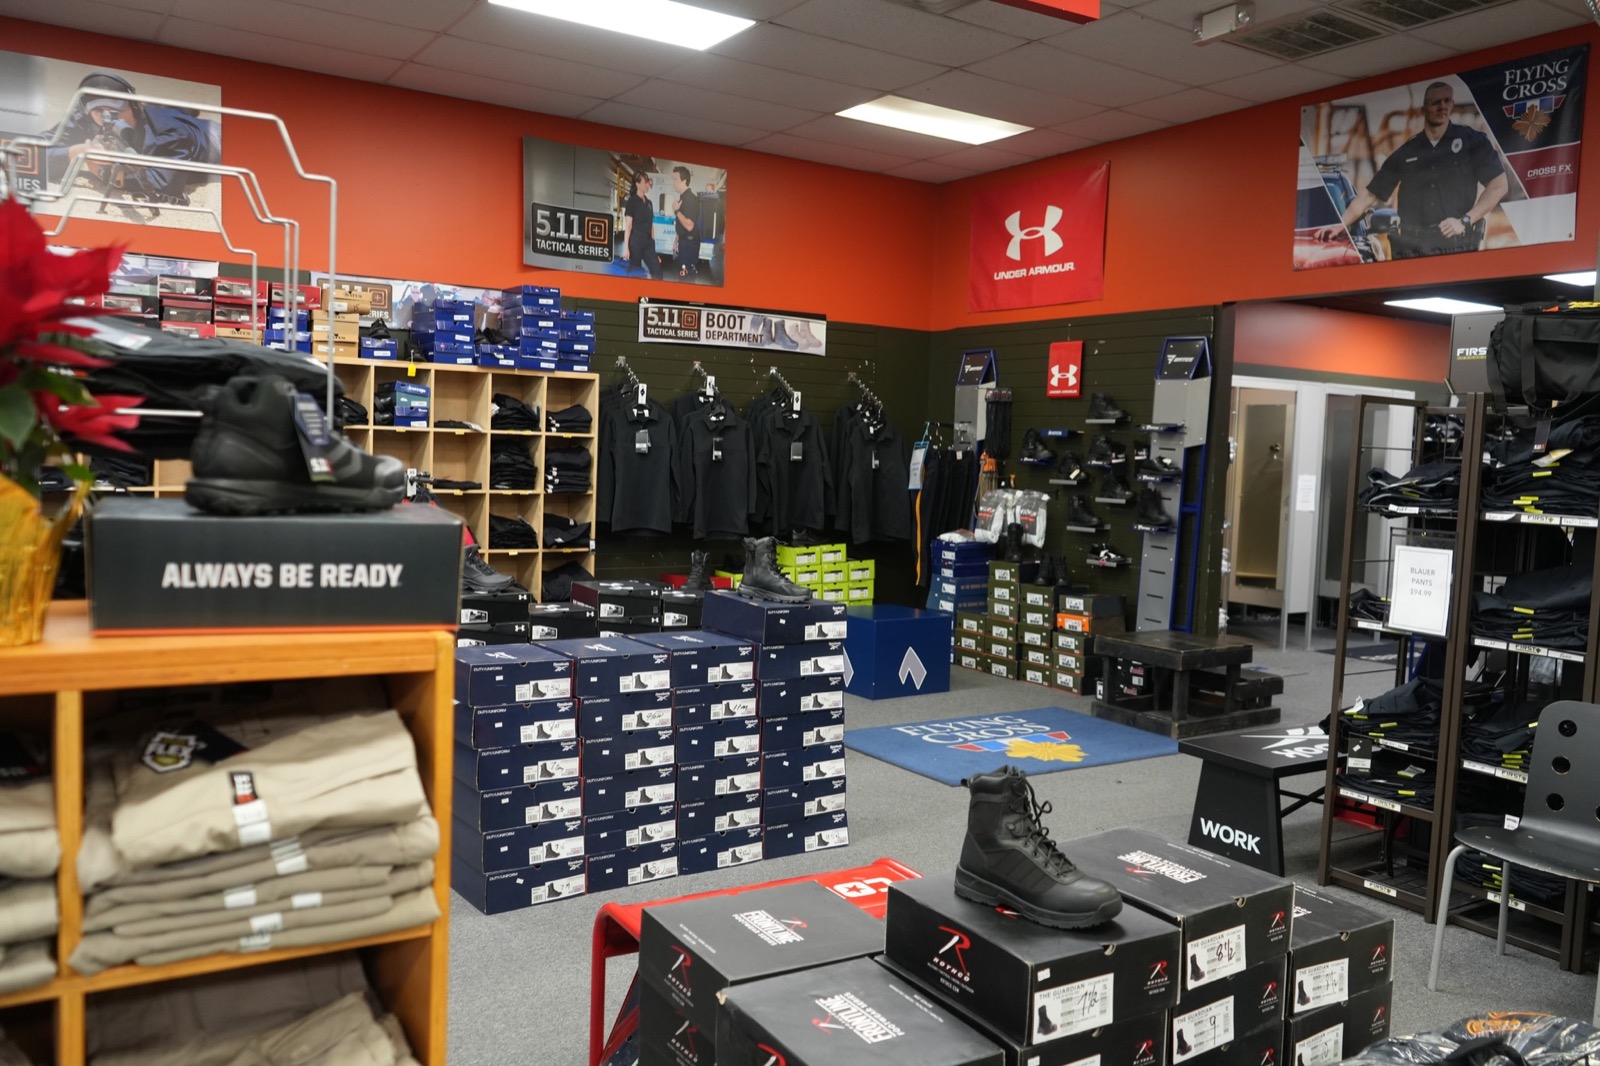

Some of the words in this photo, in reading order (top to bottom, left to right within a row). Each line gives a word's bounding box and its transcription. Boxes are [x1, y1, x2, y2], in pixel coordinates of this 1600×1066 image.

[1504, 59, 1569, 86] FLYING
[1502, 75, 1567, 101] CROSS
[1527, 166, 1556, 177] CROSS
[1559, 163, 1571, 172] FX
[536, 209, 582, 241] 5.11
[536, 238, 577, 255] TACTICAL
[578, 243, 609, 258] SERIES
[994, 269, 1027, 280] UNDER
[1028, 262, 1074, 276] ARMOUR
[647, 307, 680, 327] 5.11
[705, 313, 746, 330] BOOT
[646, 327, 677, 338] TACTICAL
[677, 329, 699, 339] SERIES
[705, 329, 764, 344] DEPARTMENT
[162, 562, 272, 588] ALWAYS
[280, 562, 313, 588] BE
[320, 562, 403, 588] READY
[1410, 567, 1436, 576] BLAUER
[1410, 588, 1431, 597] $94.99
[1411, 578, 1432, 587] PANTS
[891, 715, 1027, 737] FLYING
[921, 722, 1050, 744] CROSS
[1200, 817, 1261, 855] WORK
[742, 911, 801, 945] FRONTLINE
[1201, 934, 1224, 946] GUARDIAN
[932, 957, 970, 982] ROTHCO
[667, 973, 691, 997] ROTHCO
[1053, 983, 1085, 997] GUARDIAN
[1187, 1006, 1212, 1019] GUARDIAN
[671, 1038, 698, 1063] ROTHCO
